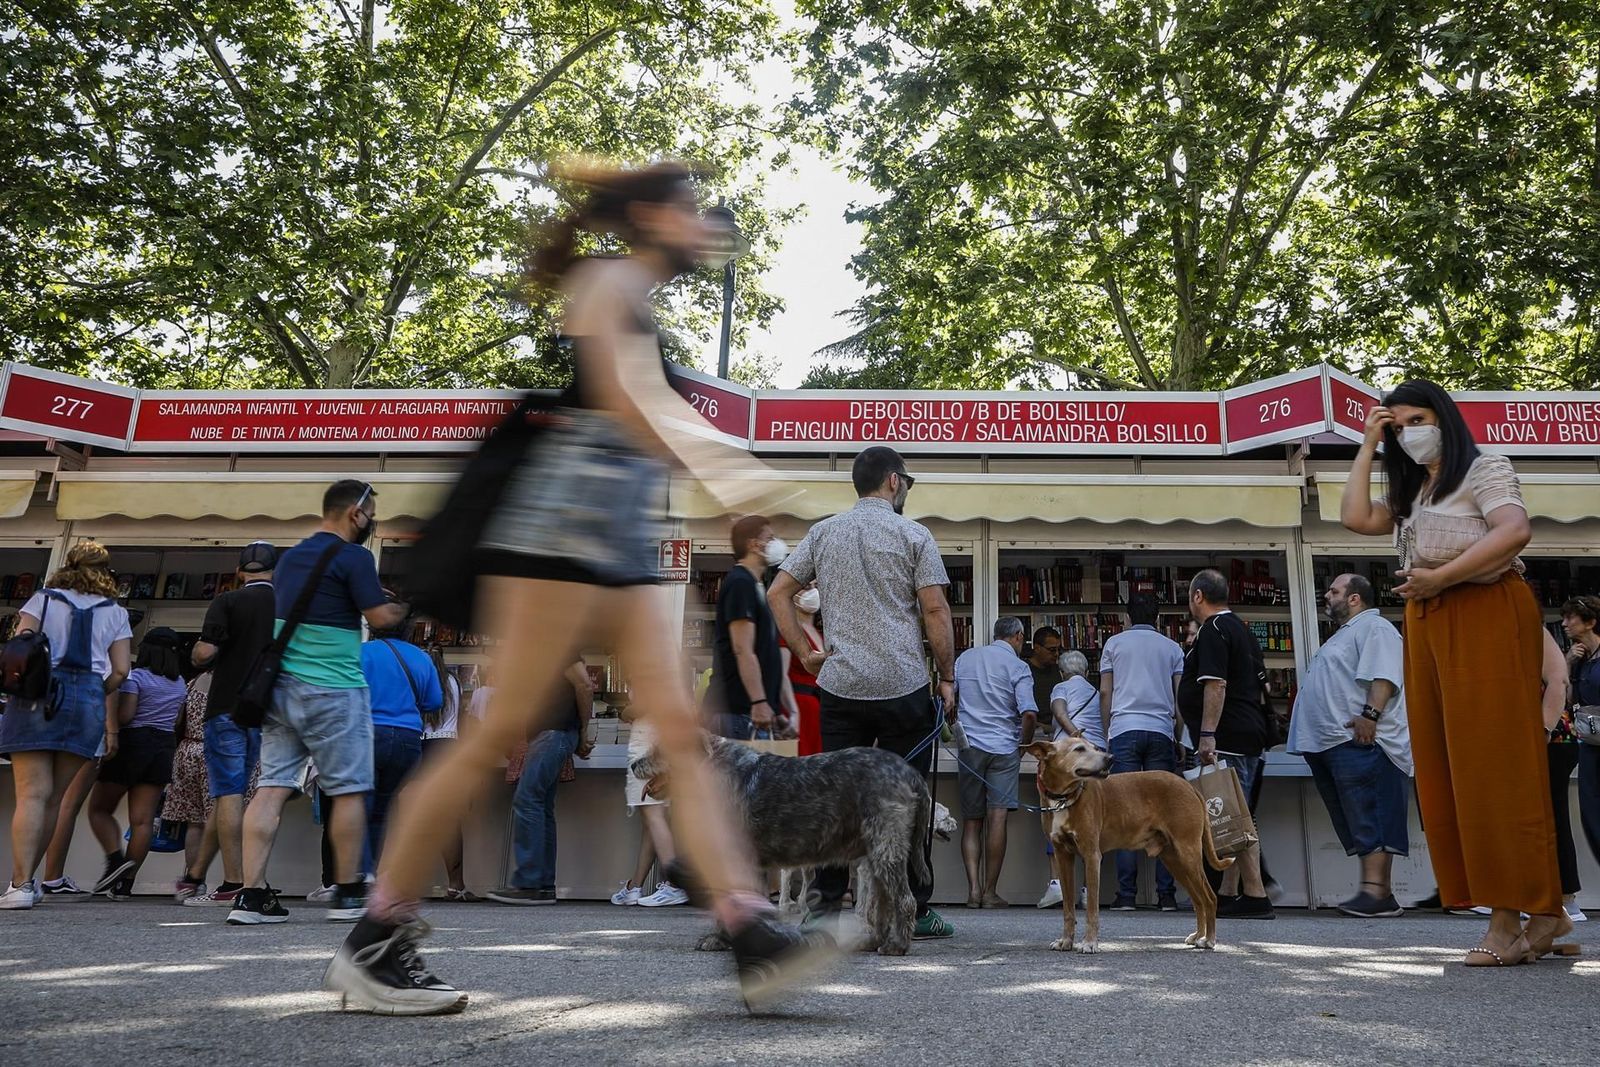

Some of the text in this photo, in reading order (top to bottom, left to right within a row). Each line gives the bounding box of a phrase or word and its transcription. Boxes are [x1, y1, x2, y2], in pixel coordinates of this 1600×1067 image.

[51, 395, 94, 420] 277
[158, 402, 242, 416] SALAMANDRA
[246, 402, 299, 415] INFANTIL
[304, 402, 313, 415] Y
[315, 402, 367, 416] JUVENIL
[370, 402, 377, 415] /
[379, 402, 450, 415] ALFAGUARA
[454, 402, 508, 415] INFANTIL
[690, 393, 718, 418] 276
[849, 401, 964, 421] DEBOLSILLO
[997, 402, 1022, 421] DE
[1259, 398, 1291, 423] 276
[1346, 397, 1365, 422] 275
[1505, 402, 1600, 422] EDICIONES
[190, 426, 224, 439] NUBE
[231, 426, 249, 439] DE
[252, 426, 286, 439] TINTA
[289, 426, 296, 439] /
[298, 426, 358, 439] MONTENA
[361, 426, 369, 439] /
[371, 426, 420, 439] MOLINO
[422, 426, 429, 439] /
[431, 426, 486, 439] RANDOM
[769, 418, 1207, 442] PENGUIN CLÁSICOS / SALAMANDRA BOLSILLO
[1486, 423, 1600, 442] NOVA / BRU
